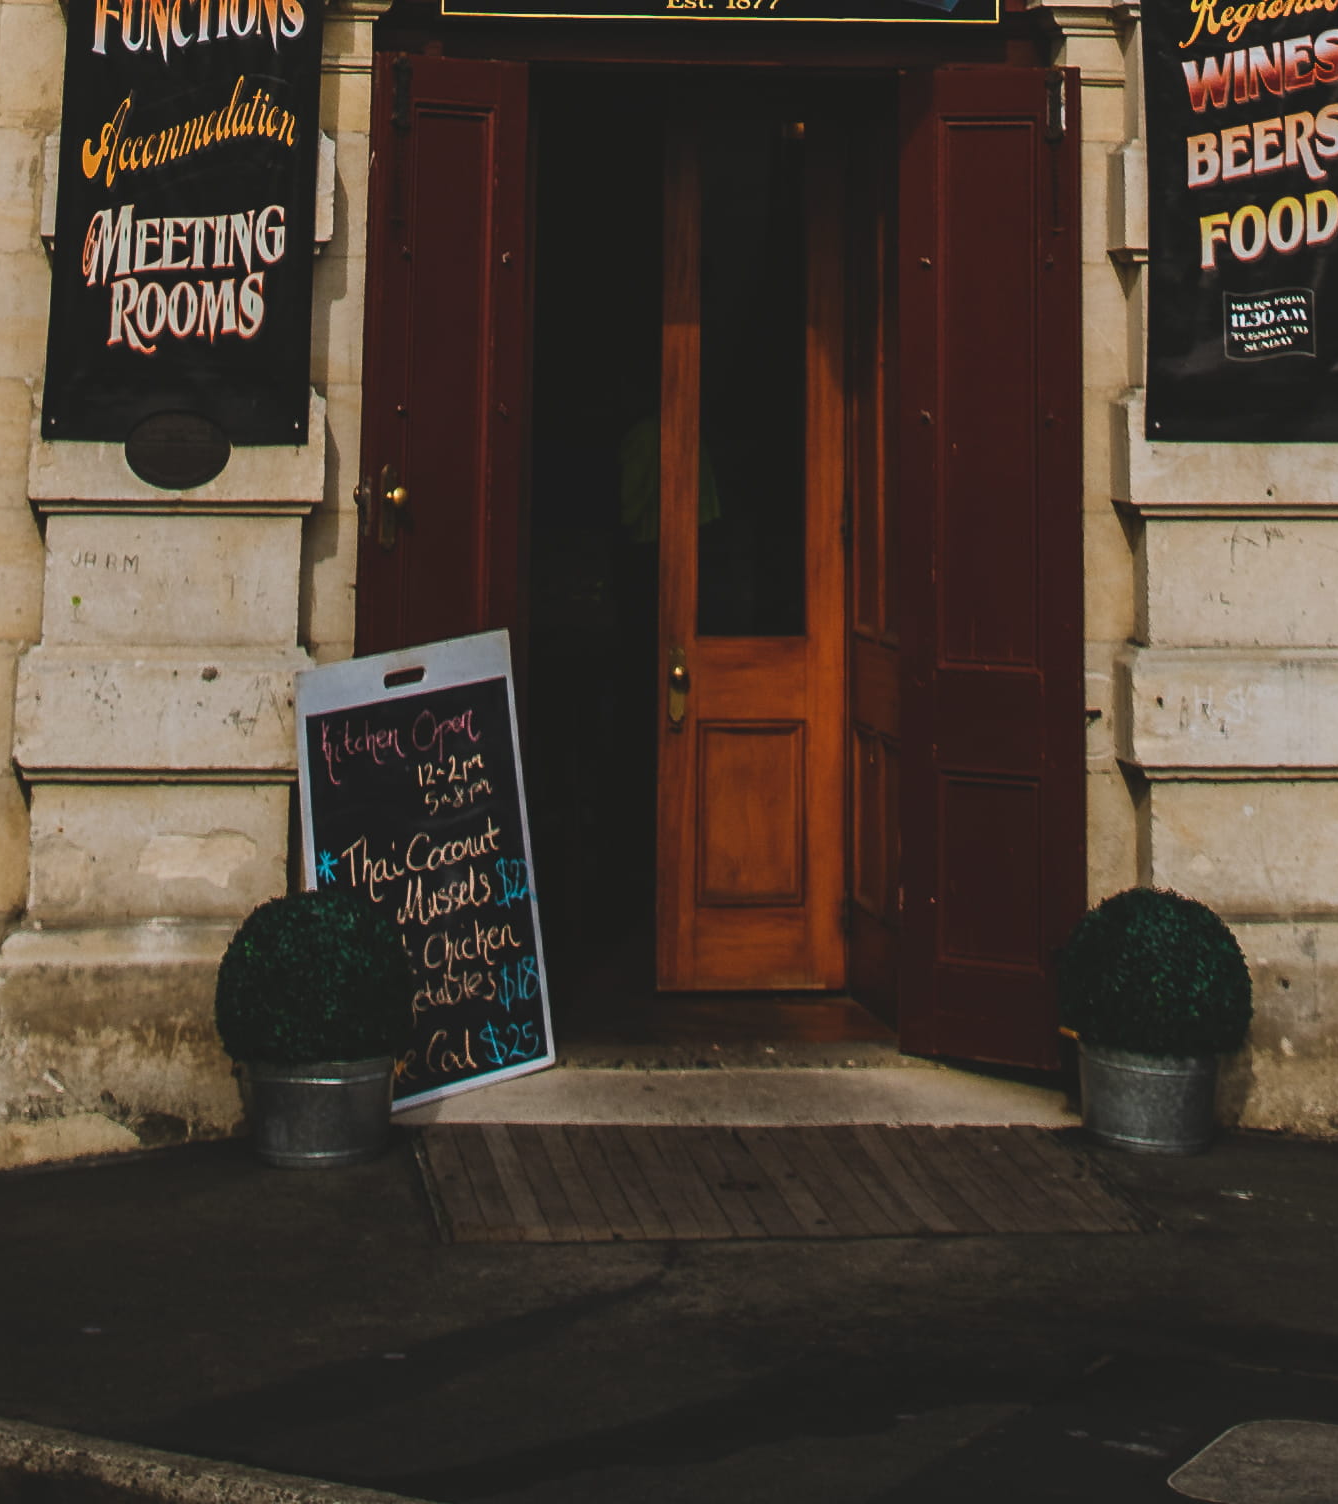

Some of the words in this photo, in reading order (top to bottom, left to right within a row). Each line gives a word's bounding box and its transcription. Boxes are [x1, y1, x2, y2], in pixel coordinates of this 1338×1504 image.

[82, 75, 296, 188] Accommodation
[83, 204, 285, 286] MEETING
[107, 272, 265, 354] ROOMS
[322, 720, 406, 785] Kitchen
[413, 709, 481, 763] Open
[340, 835, 404, 902] Thai
[406, 816, 500, 871] Coconut
[397, 864, 491, 925] Mussels
[424, 919, 521, 982] Chicken
[412, 971, 497, 1026] etables
[498, 956, 540, 1012] $18
[479, 1020, 539, 1065] $25
